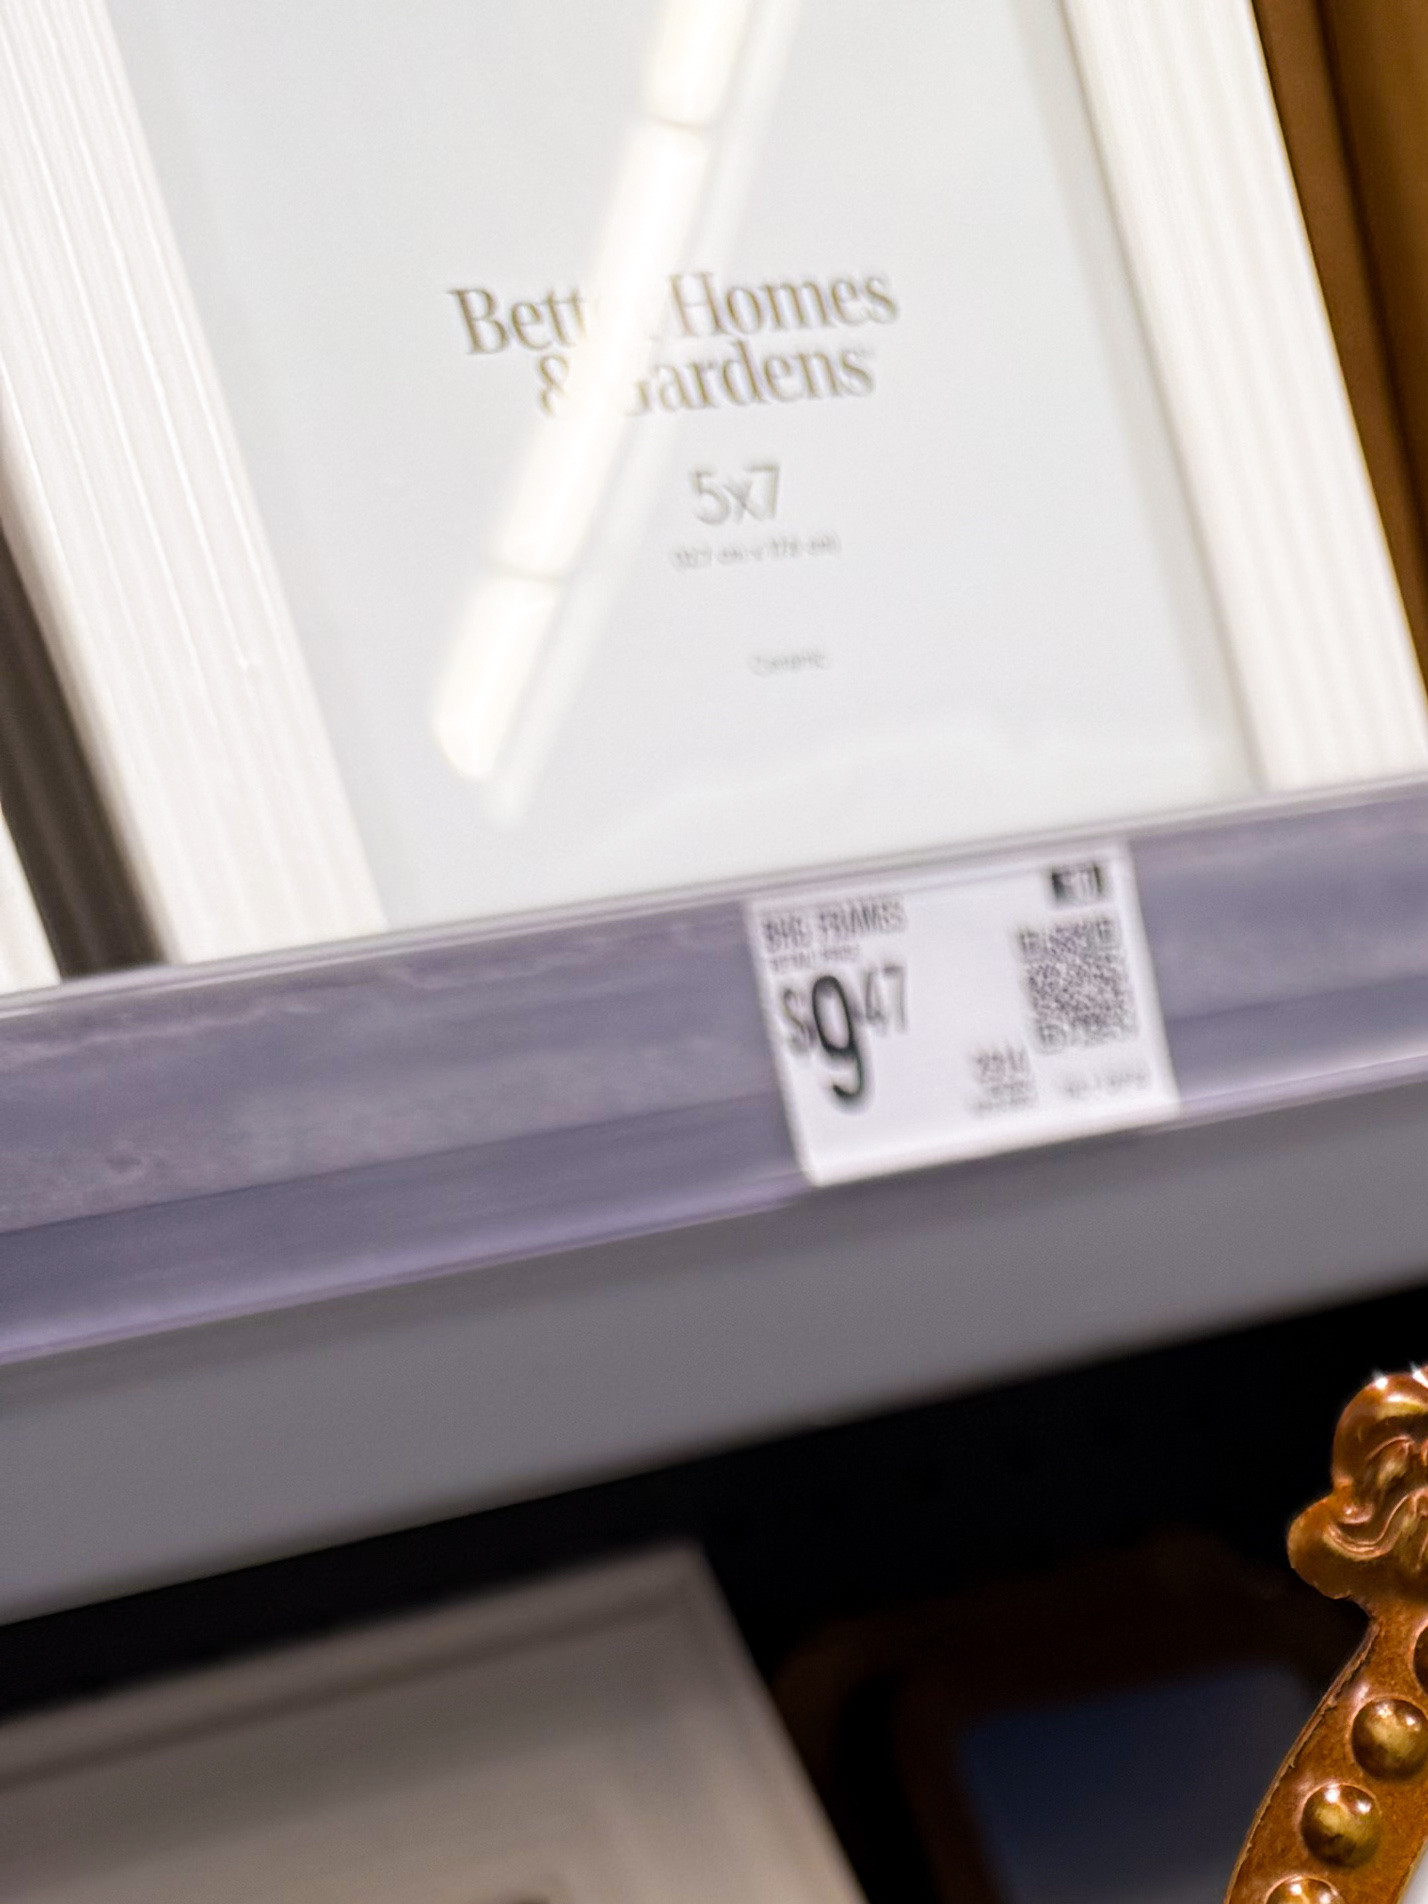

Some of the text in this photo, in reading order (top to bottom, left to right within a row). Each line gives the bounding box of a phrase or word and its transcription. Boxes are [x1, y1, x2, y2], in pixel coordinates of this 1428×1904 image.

[666, 269, 900, 340] Homes
[624, 338, 875, 417] ardens
[688, 458, 780, 527] 5x7
